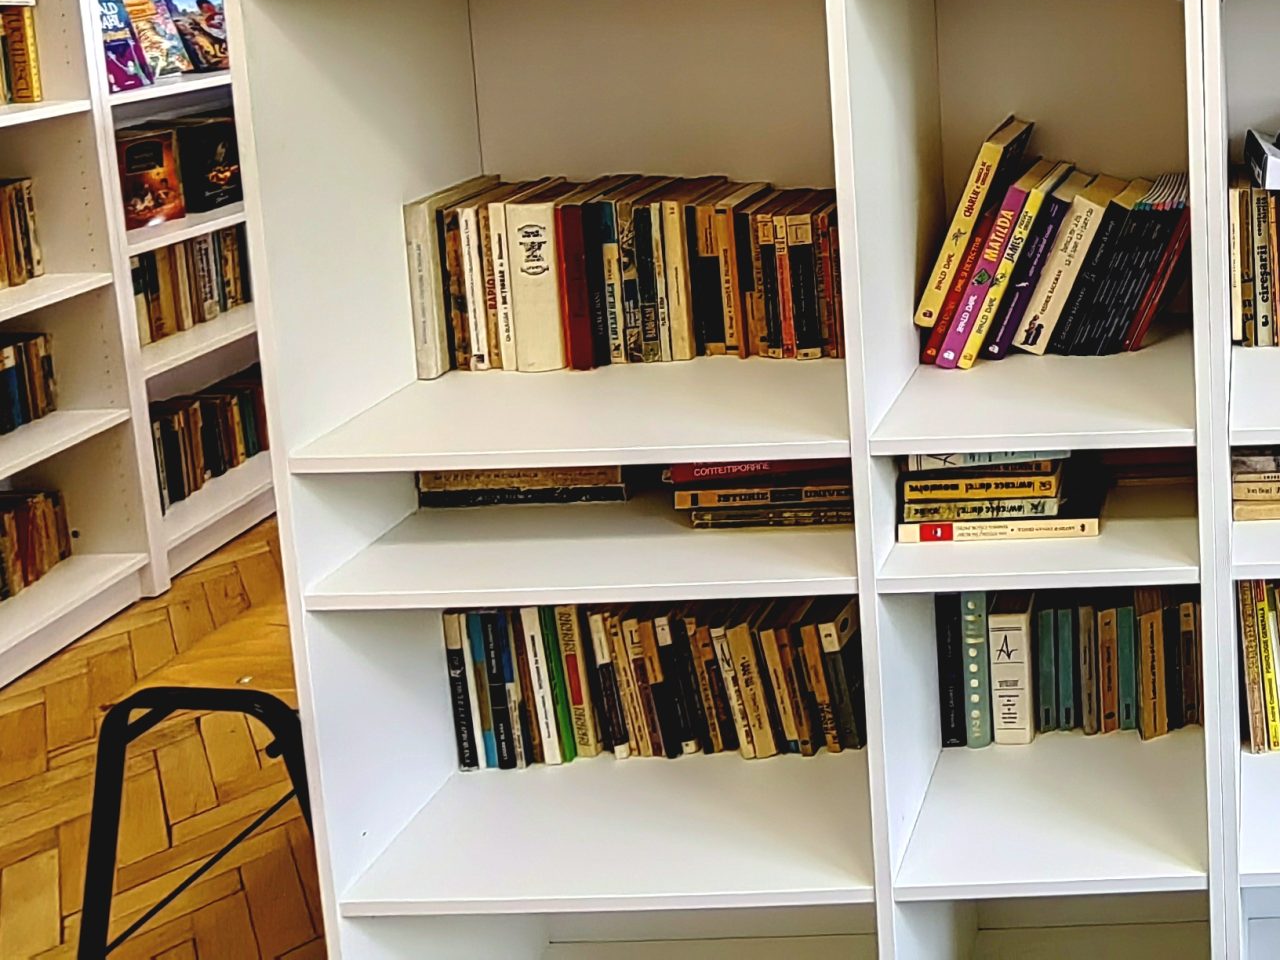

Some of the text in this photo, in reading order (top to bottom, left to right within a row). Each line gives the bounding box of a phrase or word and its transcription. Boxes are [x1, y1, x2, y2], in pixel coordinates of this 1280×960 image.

[963, 185, 982, 218] CHARLIE
[1255, 196, 1263, 237] constantin
[983, 209, 1015, 263] MATILDA
[1003, 234, 1025, 263] JAMES
[1256, 244, 1272, 303] cireșarii
[993, 480, 1035, 493] lawrence
[1258, 606, 1268, 639] GENERALĂ
